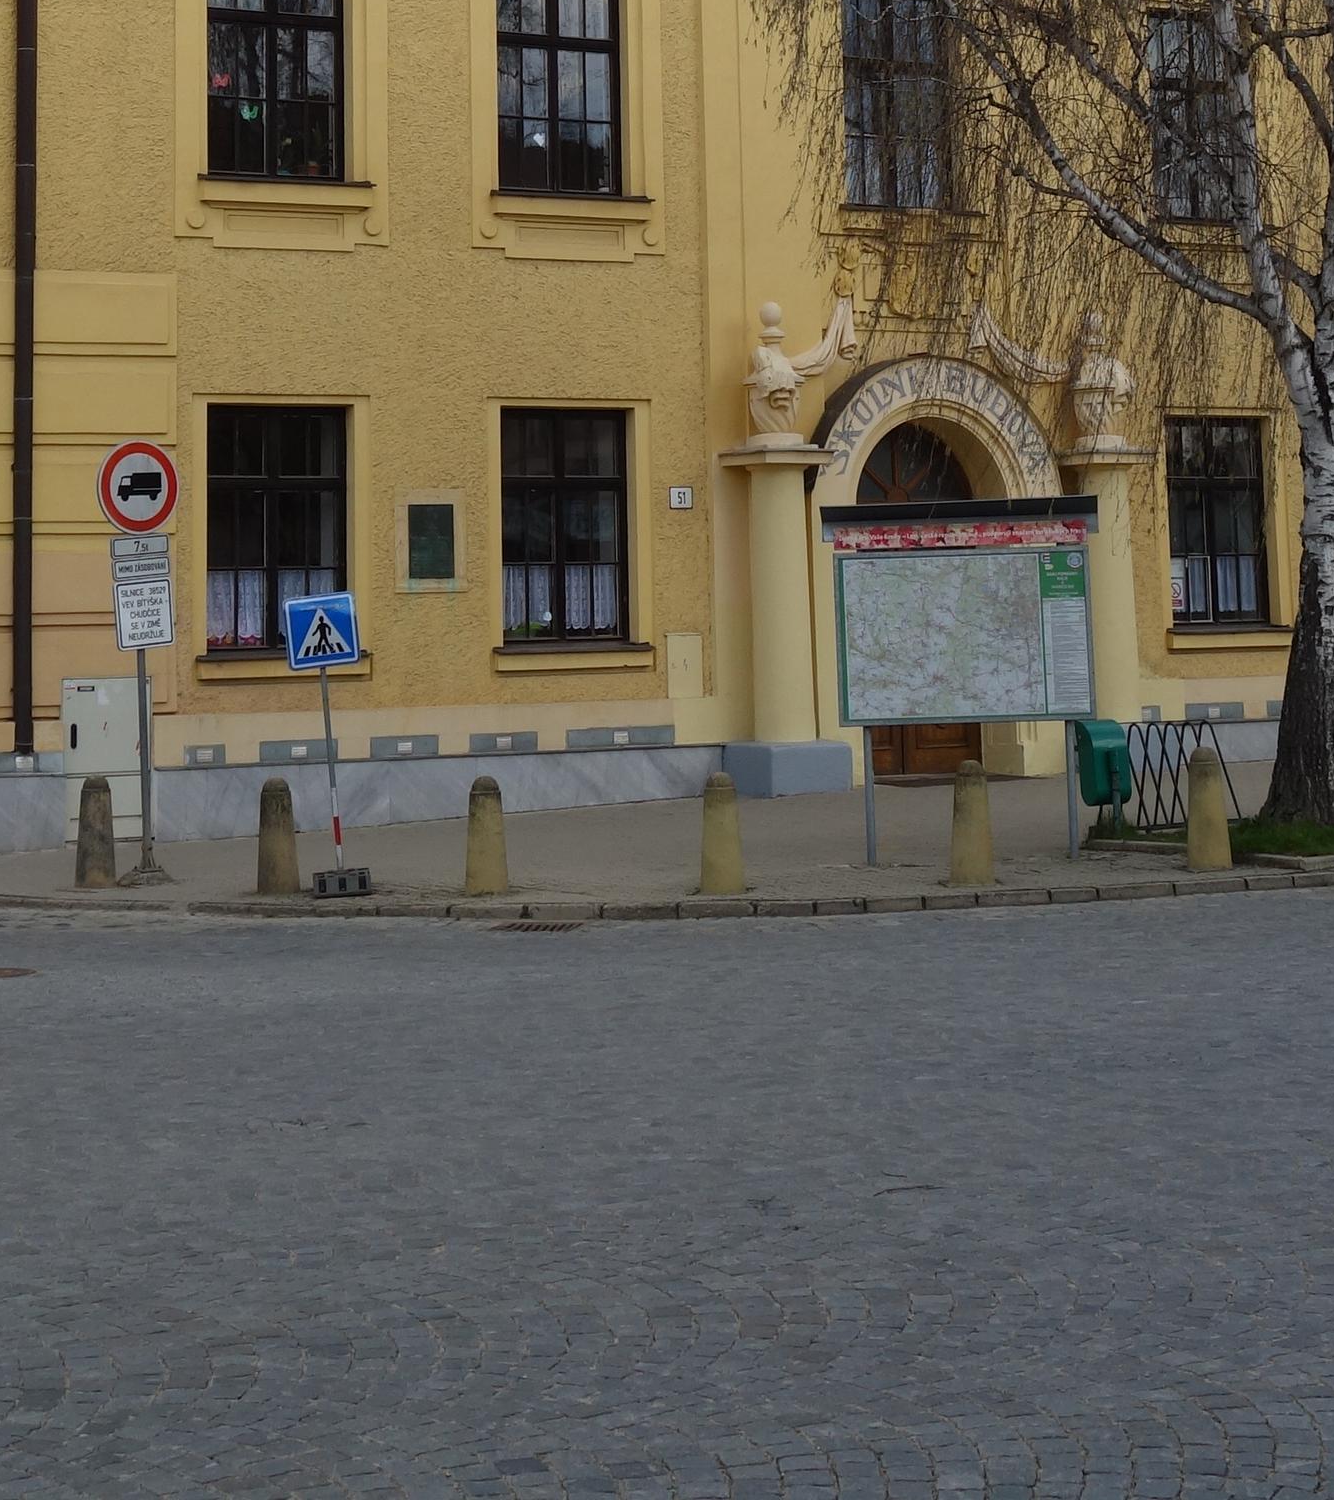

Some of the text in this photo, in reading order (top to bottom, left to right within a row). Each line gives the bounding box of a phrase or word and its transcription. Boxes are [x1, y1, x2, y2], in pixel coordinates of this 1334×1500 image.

[677, 491, 686, 505] 51
[118, 564, 134, 574] MIMO
[120, 587, 144, 598] SILNICE
[130, 621, 140, 630] SE
